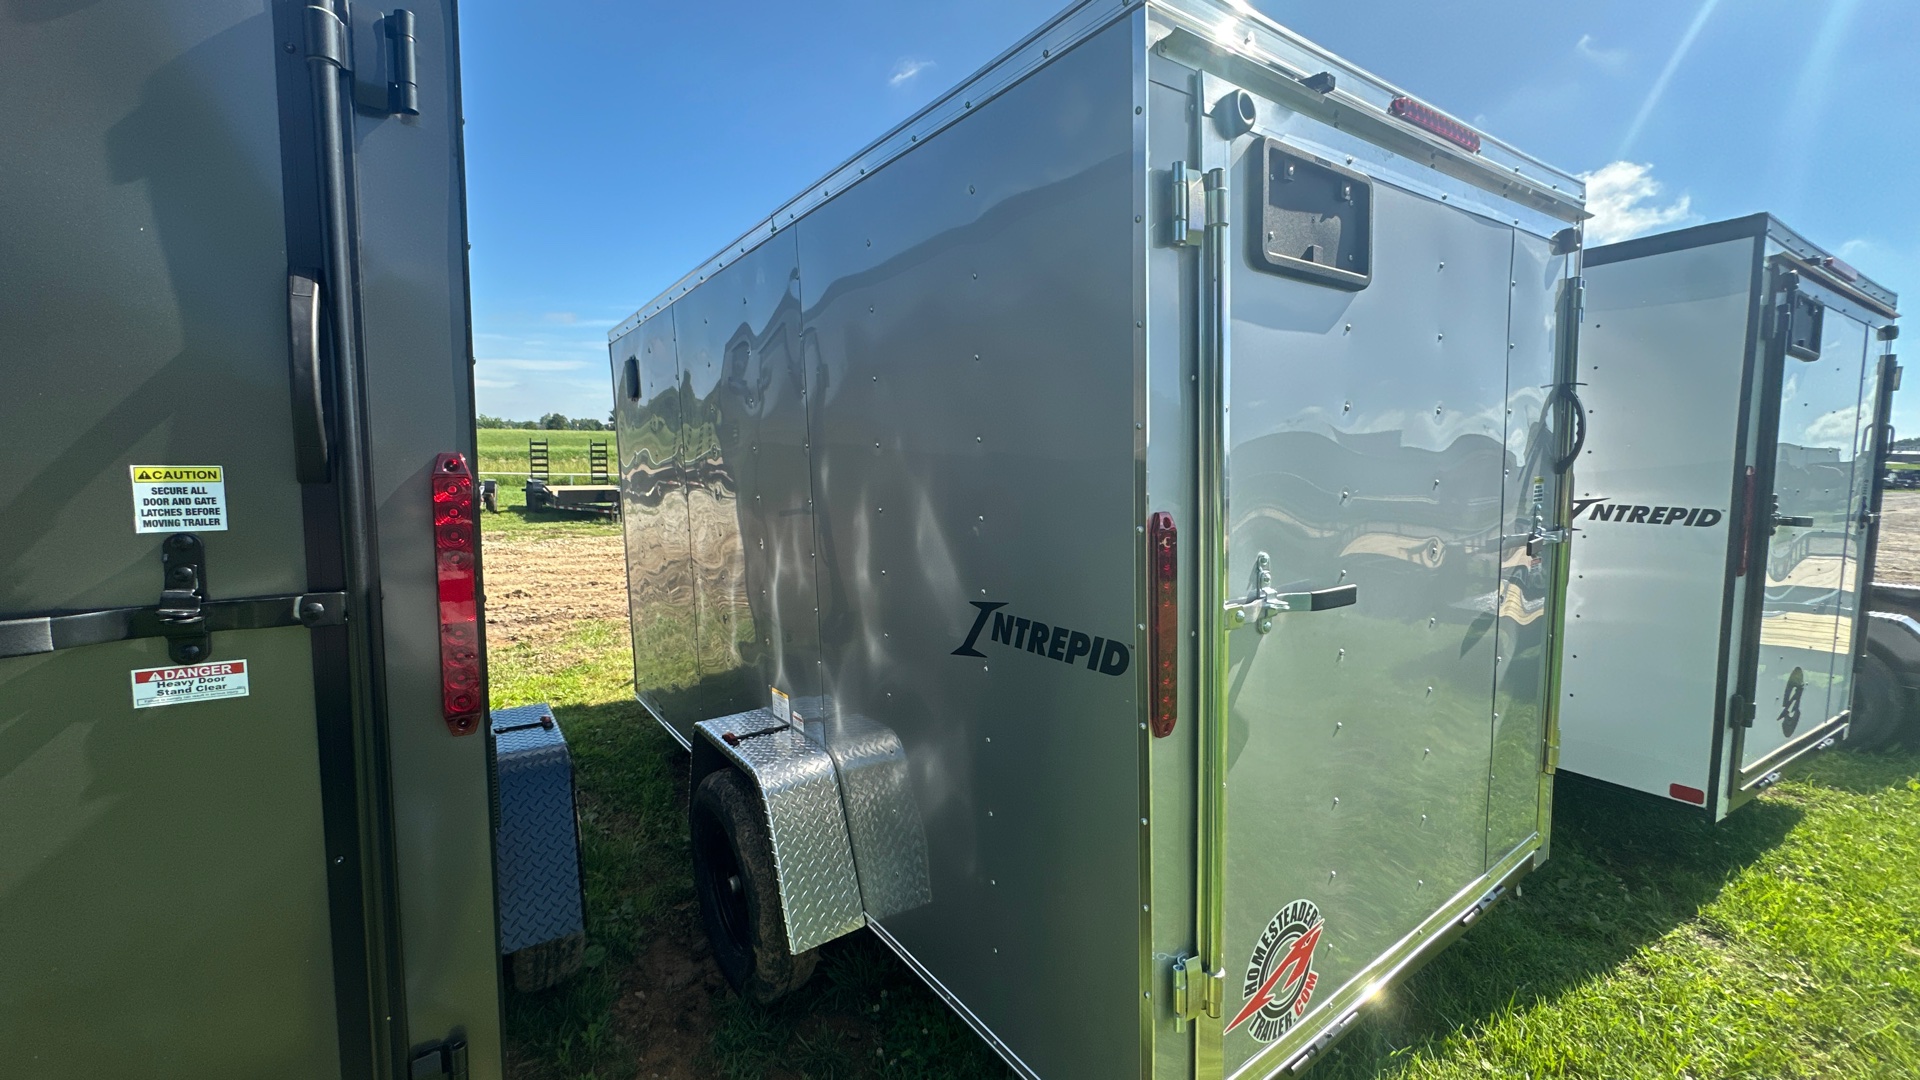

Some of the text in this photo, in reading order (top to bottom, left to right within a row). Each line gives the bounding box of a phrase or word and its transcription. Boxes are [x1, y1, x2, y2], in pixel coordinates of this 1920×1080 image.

[152, 470, 217, 480] CAUTION
[151, 486, 208, 495] SECURE ALL
[142, 496, 217, 506] DOOR AND GATE
[140, 507, 221, 517] LATCHES BEFORE
[142, 518, 221, 528] MOVING TRAILER
[950, 601, 1130, 677] INTREPID
[163, 664, 232, 680] DANGER
[157, 676, 226, 689] Heavy Door
[156, 687, 192, 696] Stand
[196, 683, 227, 692] Clear
[1244, 901, 1318, 999] HOMESTEADER
